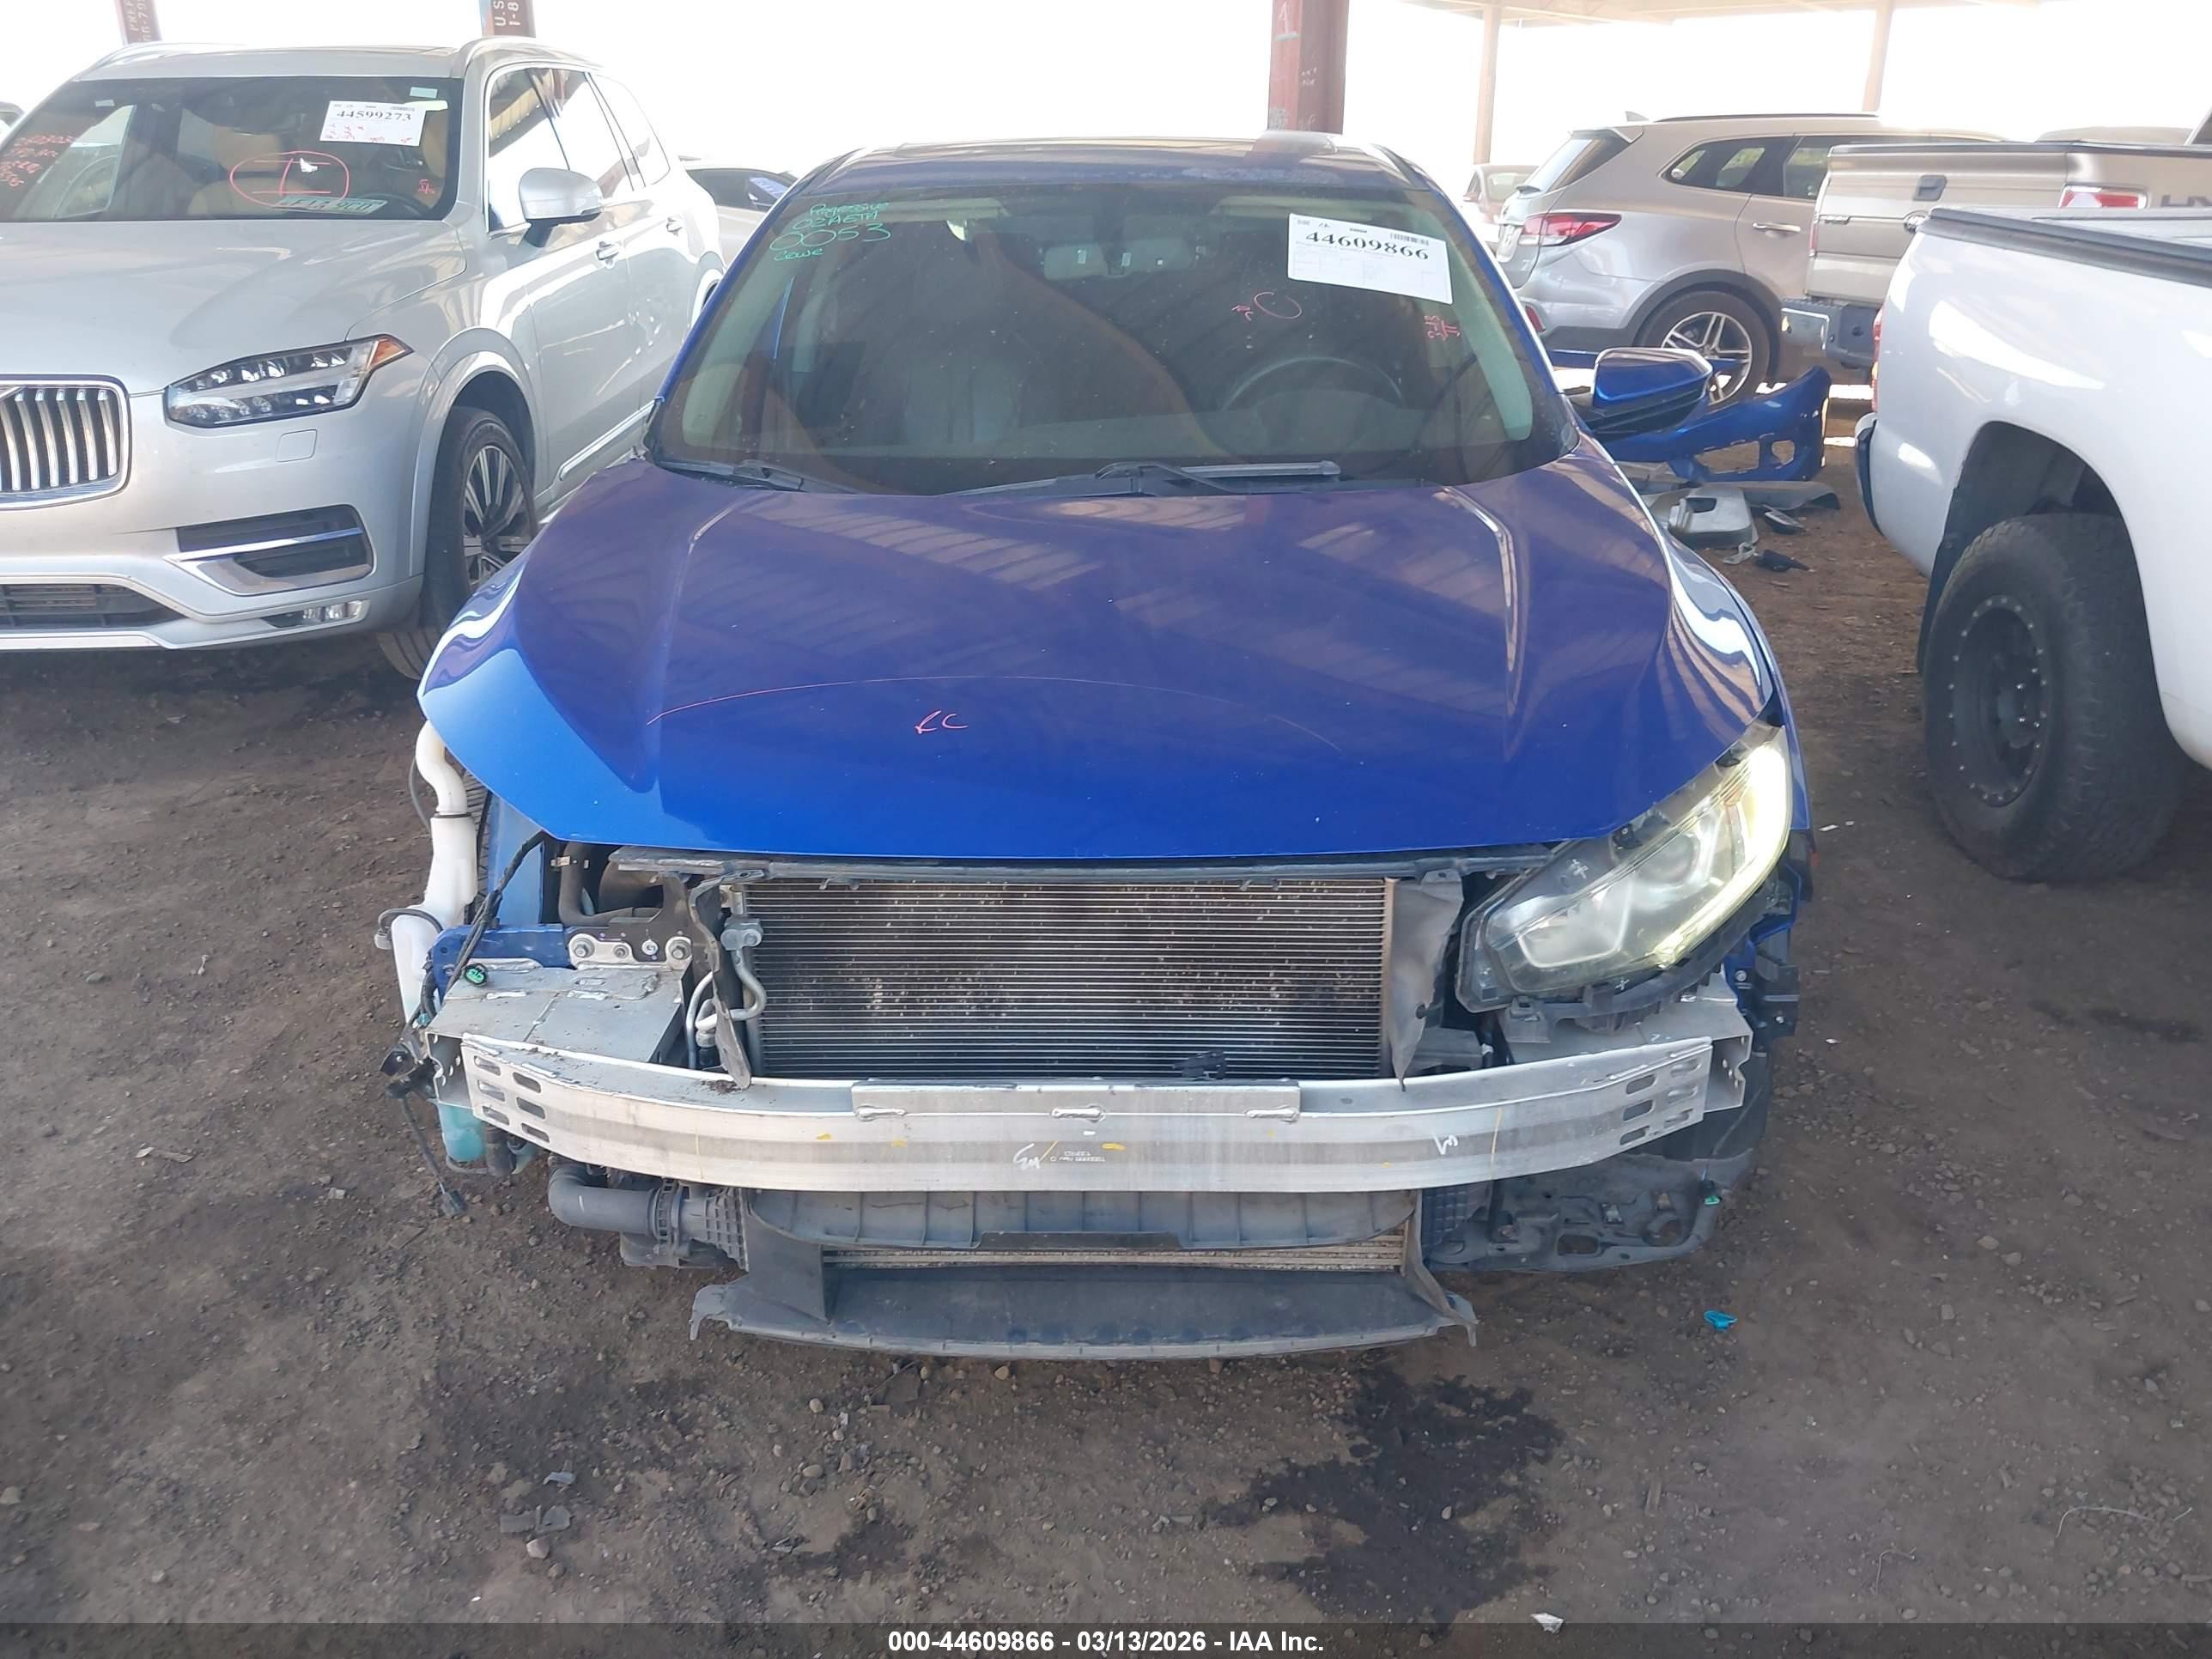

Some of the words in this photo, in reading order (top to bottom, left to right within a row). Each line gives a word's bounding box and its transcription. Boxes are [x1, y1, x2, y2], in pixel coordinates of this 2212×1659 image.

[337, 110, 411, 121] 44599273
[769, 223, 890, 251] 0053
[1305, 232, 1429, 260] 44609866
